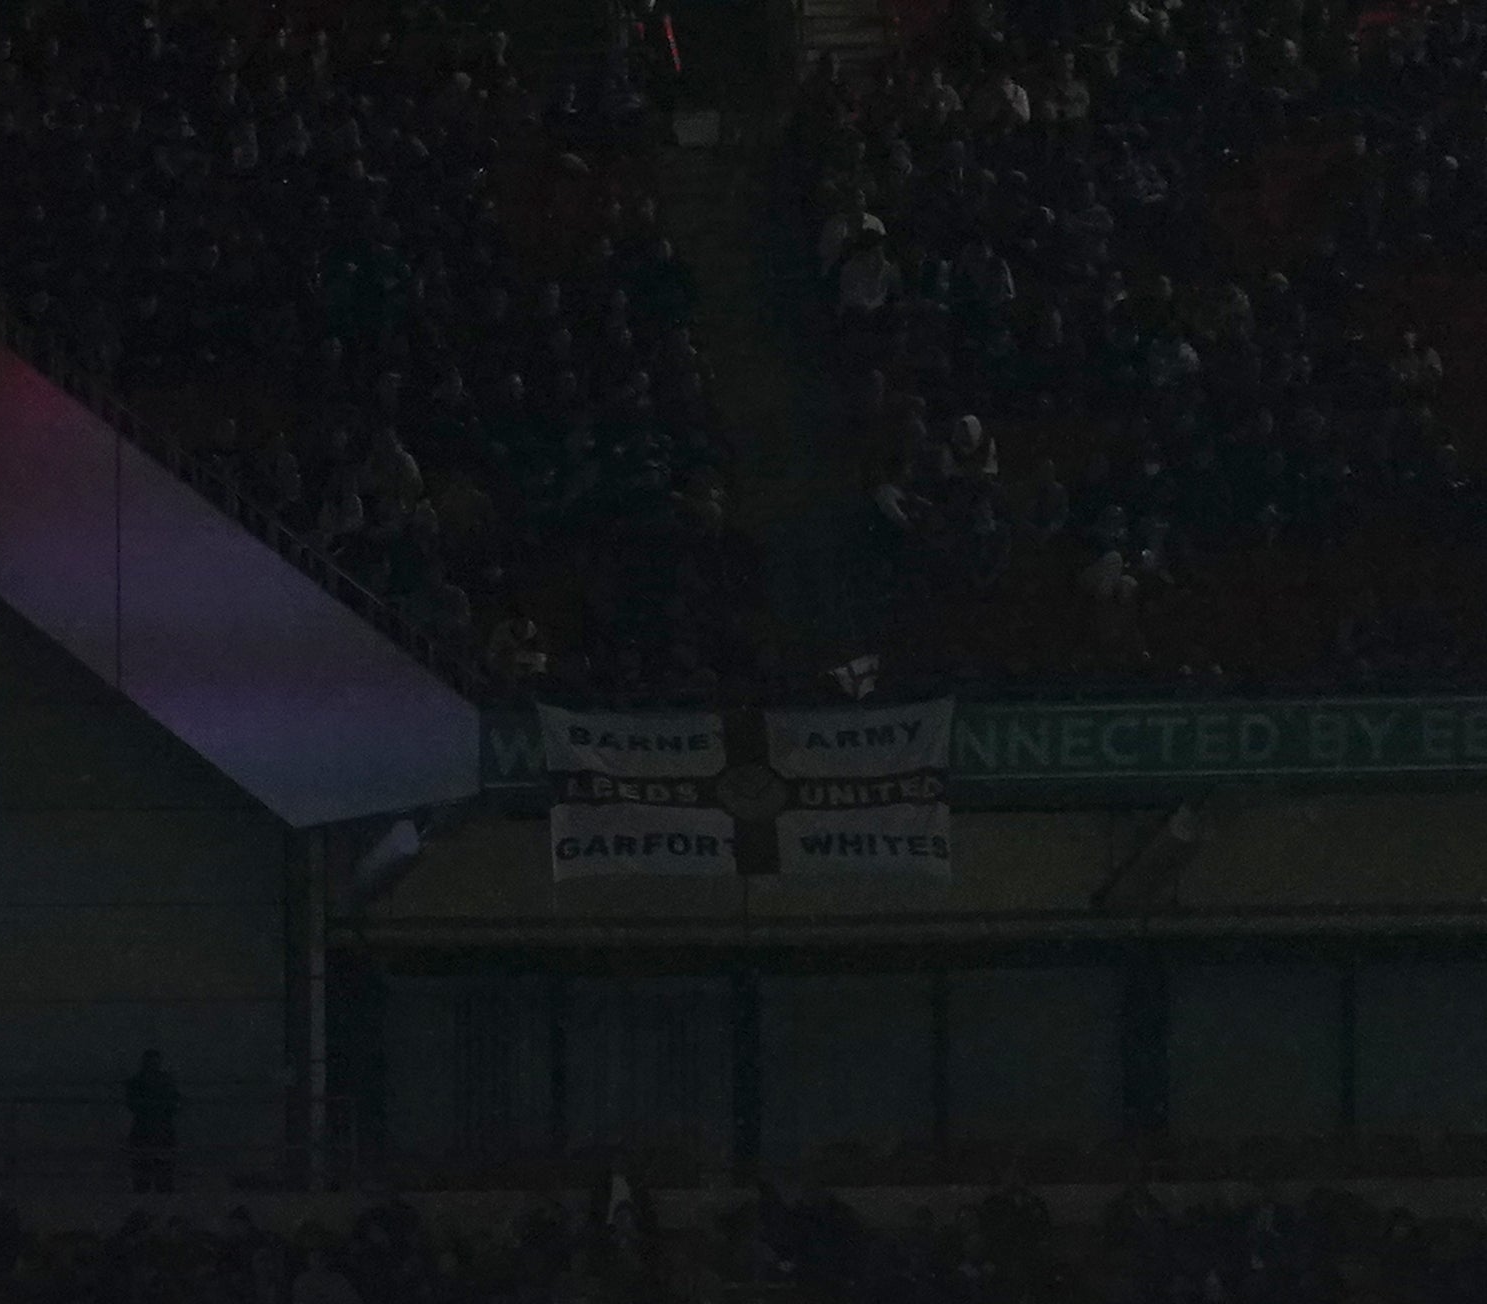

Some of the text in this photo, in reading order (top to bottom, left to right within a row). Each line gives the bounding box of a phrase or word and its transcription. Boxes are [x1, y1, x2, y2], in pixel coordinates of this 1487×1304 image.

[567, 725, 716, 752] BARNE
[805, 719, 922, 750] ARMY
[955, 713, 1279, 769] NNECTED
[1308, 709, 1401, 761] BY
[799, 775, 943, 806] UNITED
[799, 834, 949, 858] WHITES
